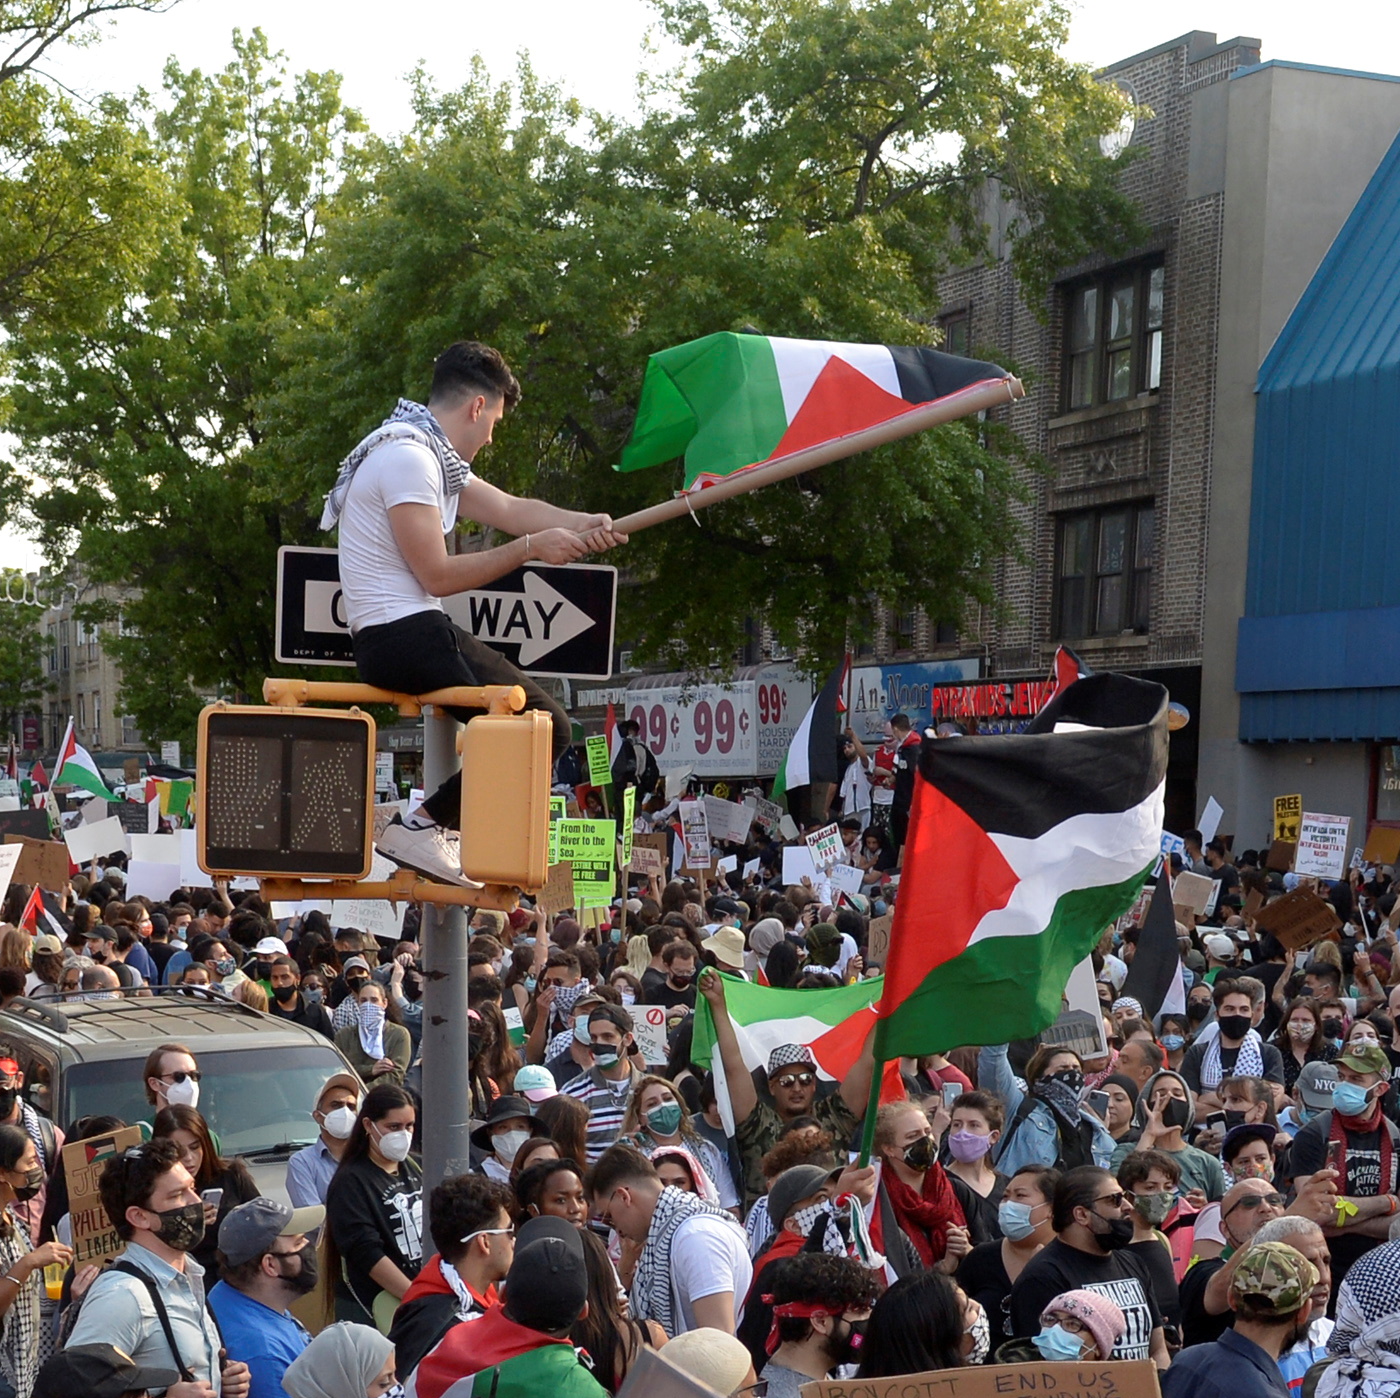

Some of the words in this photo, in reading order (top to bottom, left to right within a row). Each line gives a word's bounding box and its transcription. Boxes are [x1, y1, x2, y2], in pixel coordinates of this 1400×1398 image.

[469, 597, 564, 640] WAY
[931, 683, 1006, 718] PYRAMIDS
[758, 749, 784, 759] SCHOOL
[1276, 797, 1300, 812] FREE
[560, 823, 581, 833] From
[583, 823, 595, 833] the
[560, 836, 581, 846] River
[582, 836, 591, 845] to
[592, 836, 605, 846] the
[559, 848, 575, 858] Sea
[580, 871, 596, 880] FREE
[1314, 1079, 1337, 1091] NYC
[72, 1162, 105, 1197] JE
[72, 1206, 111, 1238] PALE
[75, 1231, 127, 1262] LIBER
[996, 1373, 1057, 1394] END
[1077, 1370, 1115, 1390] US
